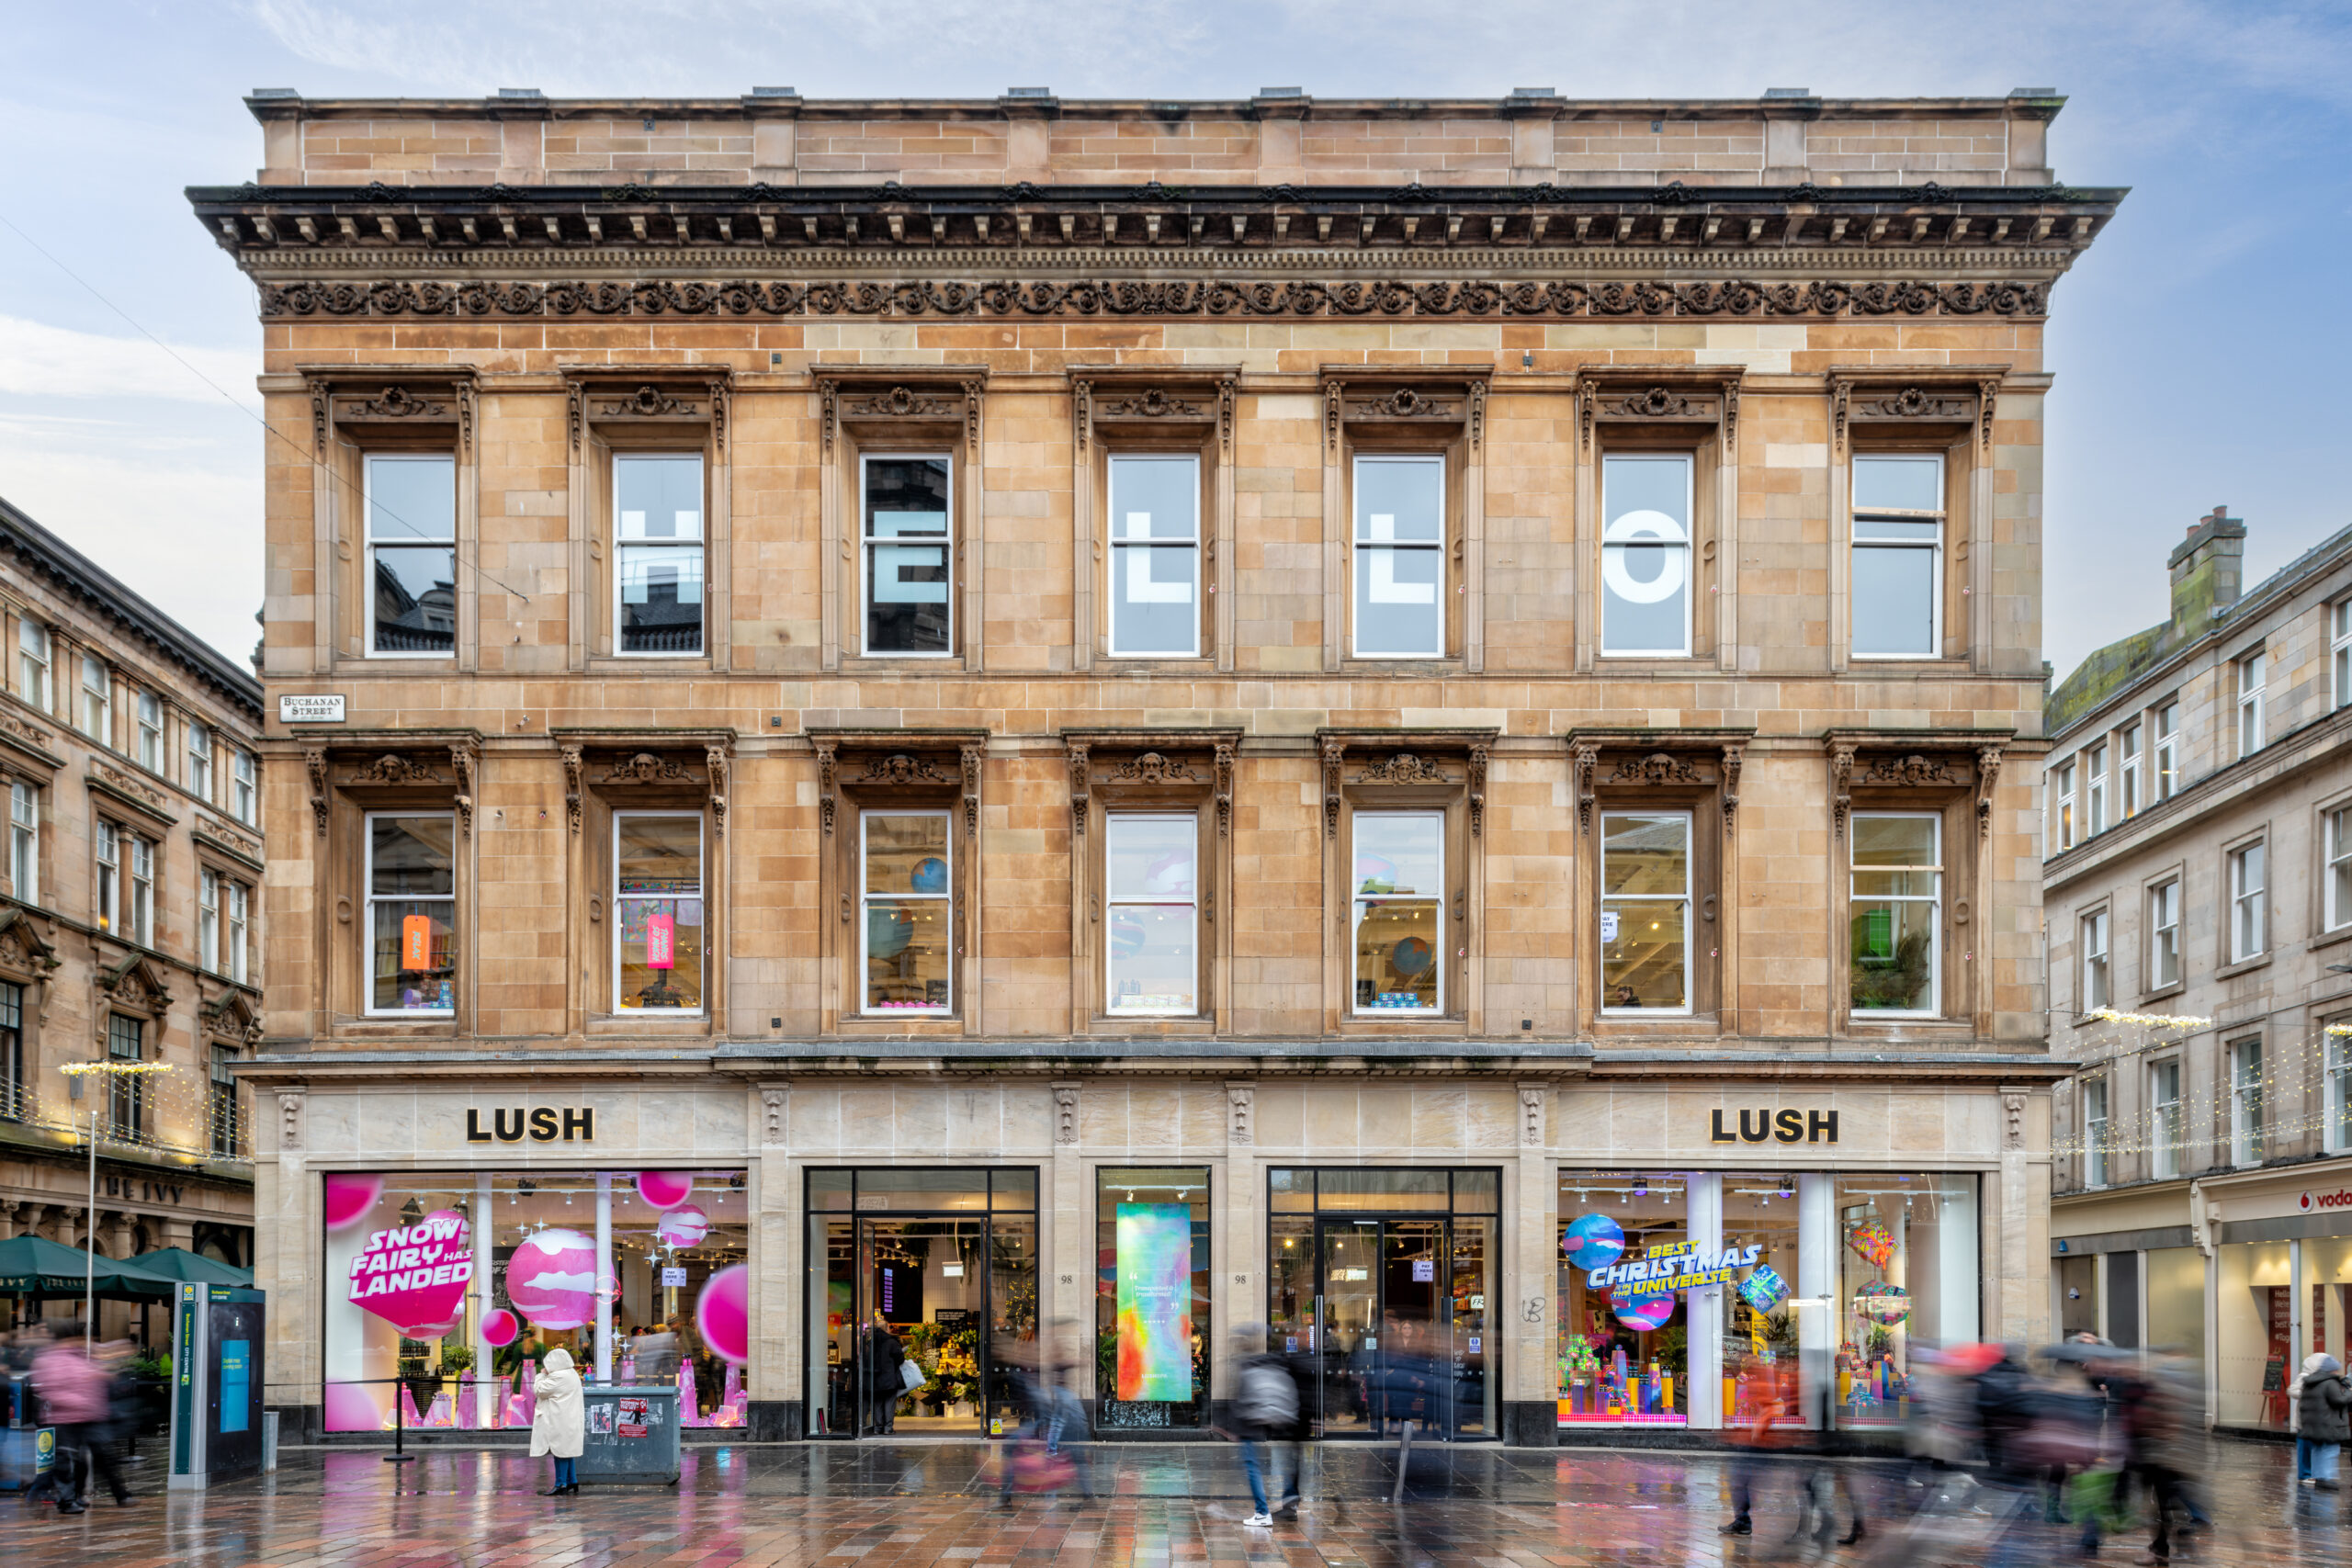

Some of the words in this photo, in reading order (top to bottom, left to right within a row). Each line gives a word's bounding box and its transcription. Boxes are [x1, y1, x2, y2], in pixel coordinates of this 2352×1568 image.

[466, 1107, 594, 1142] LUSH
[1711, 1108, 1838, 1145] LUSH
[94, 1175, 135, 1199] THE
[144, 1181, 184, 1204] IVY
[364, 1218, 463, 1253] SNOW
[1645, 1240, 1702, 1259] BEST
[349, 1243, 445, 1278] FAIRY
[443, 1248, 474, 1263] HAS
[1587, 1244, 1762, 1290] CHRISTMAS
[348, 1261, 474, 1301] LANDED
[1061, 1275, 1072, 1284] 98
[1235, 1275, 1246, 1284] 98
[1621, 1282, 1632, 1291] IN
[1632, 1268, 1733, 1296] UNIVERSE
[1611, 1290, 1630, 1300] THE
